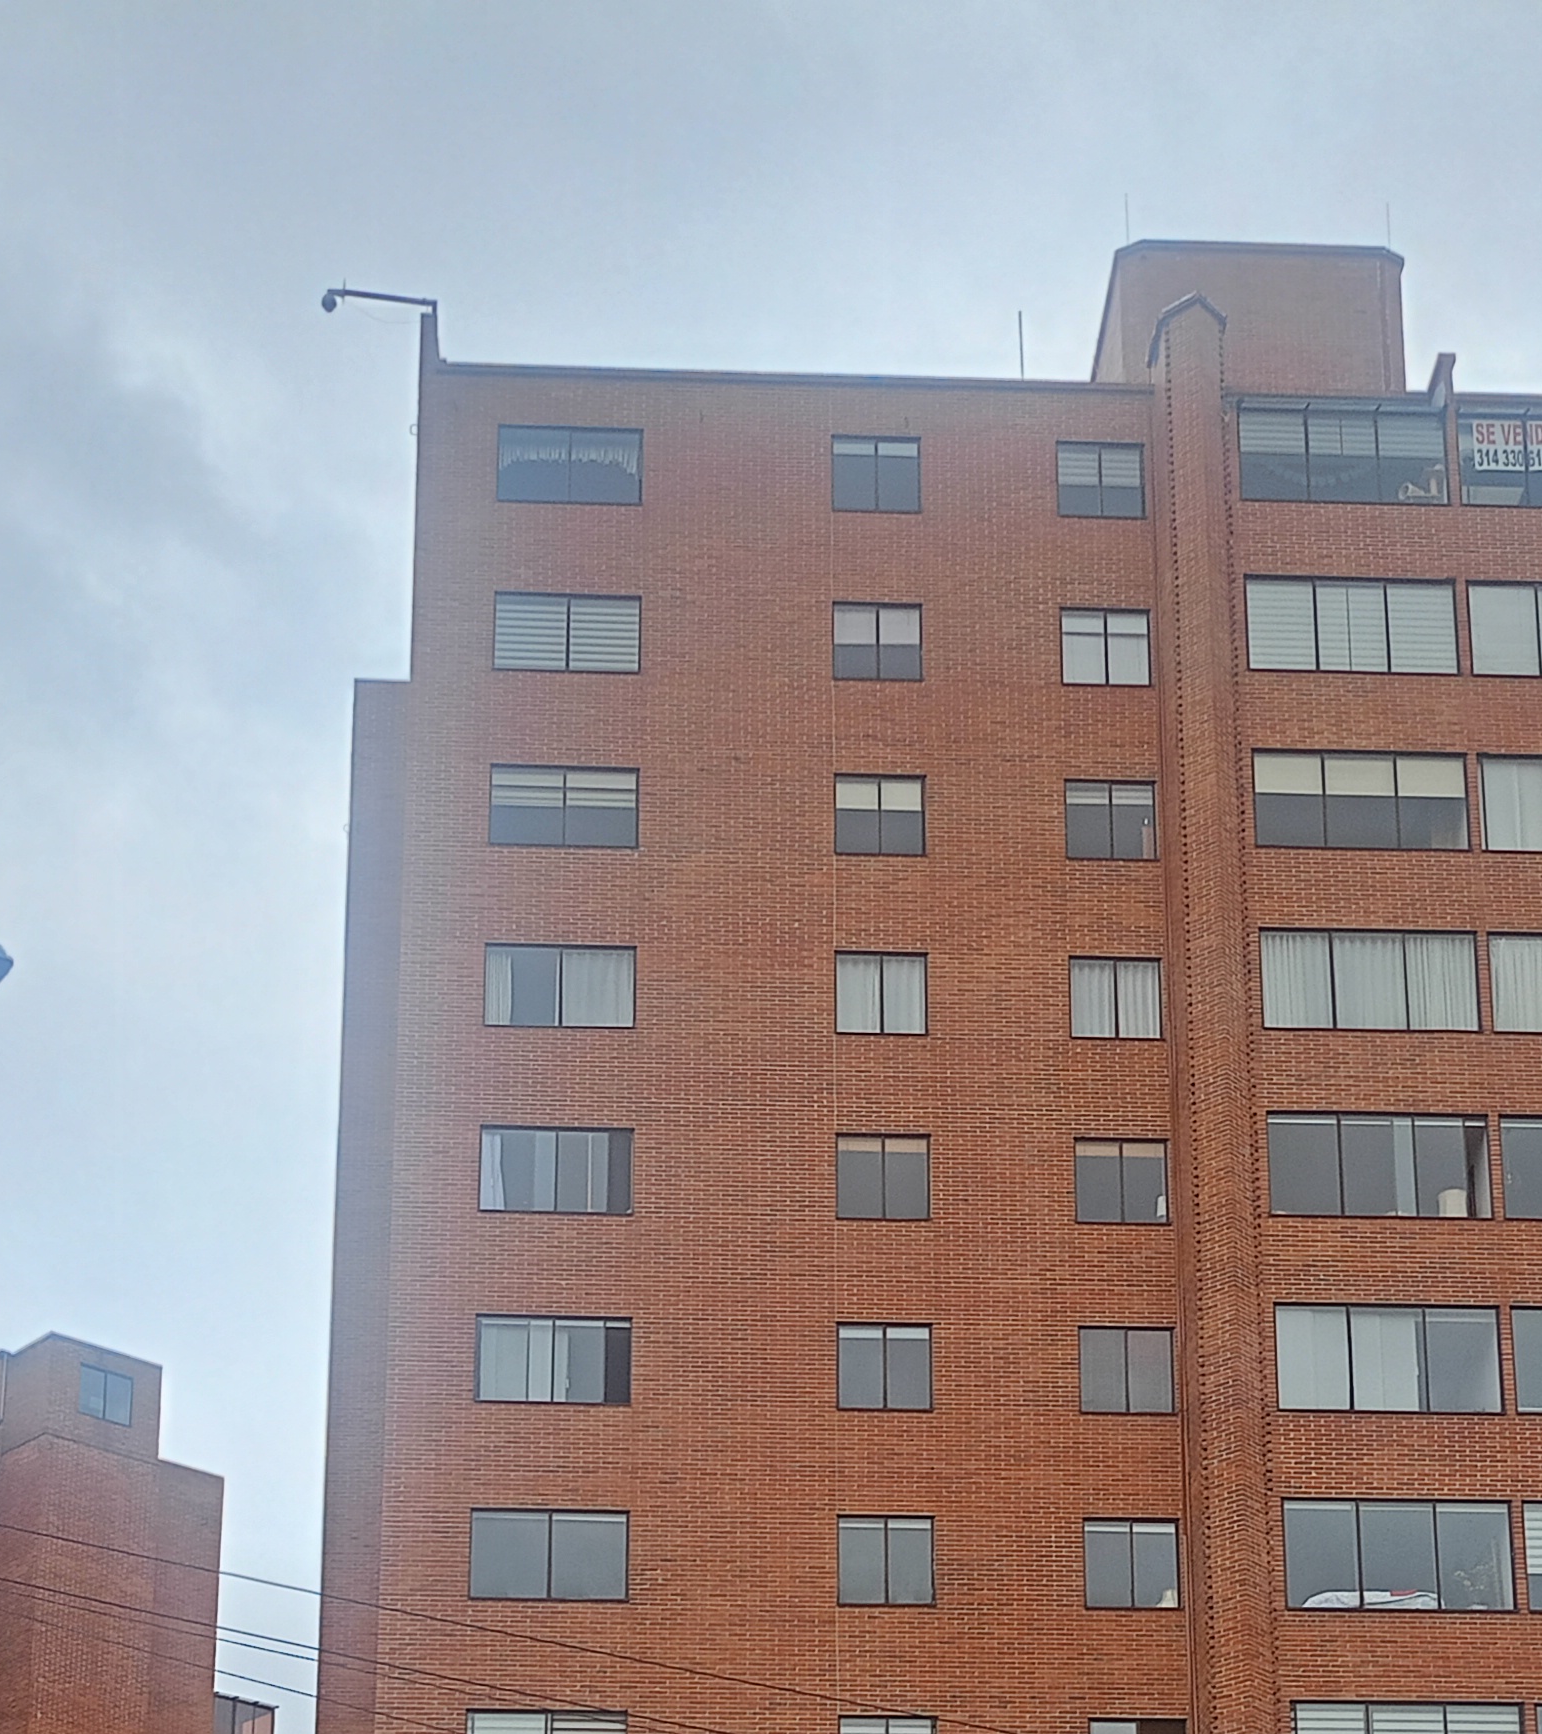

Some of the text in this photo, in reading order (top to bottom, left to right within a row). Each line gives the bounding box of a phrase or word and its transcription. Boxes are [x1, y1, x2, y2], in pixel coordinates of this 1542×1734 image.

[1476, 423, 1496, 445] SE
[1477, 449, 1499, 468] 314
[1502, 449, 1524, 468] 330
